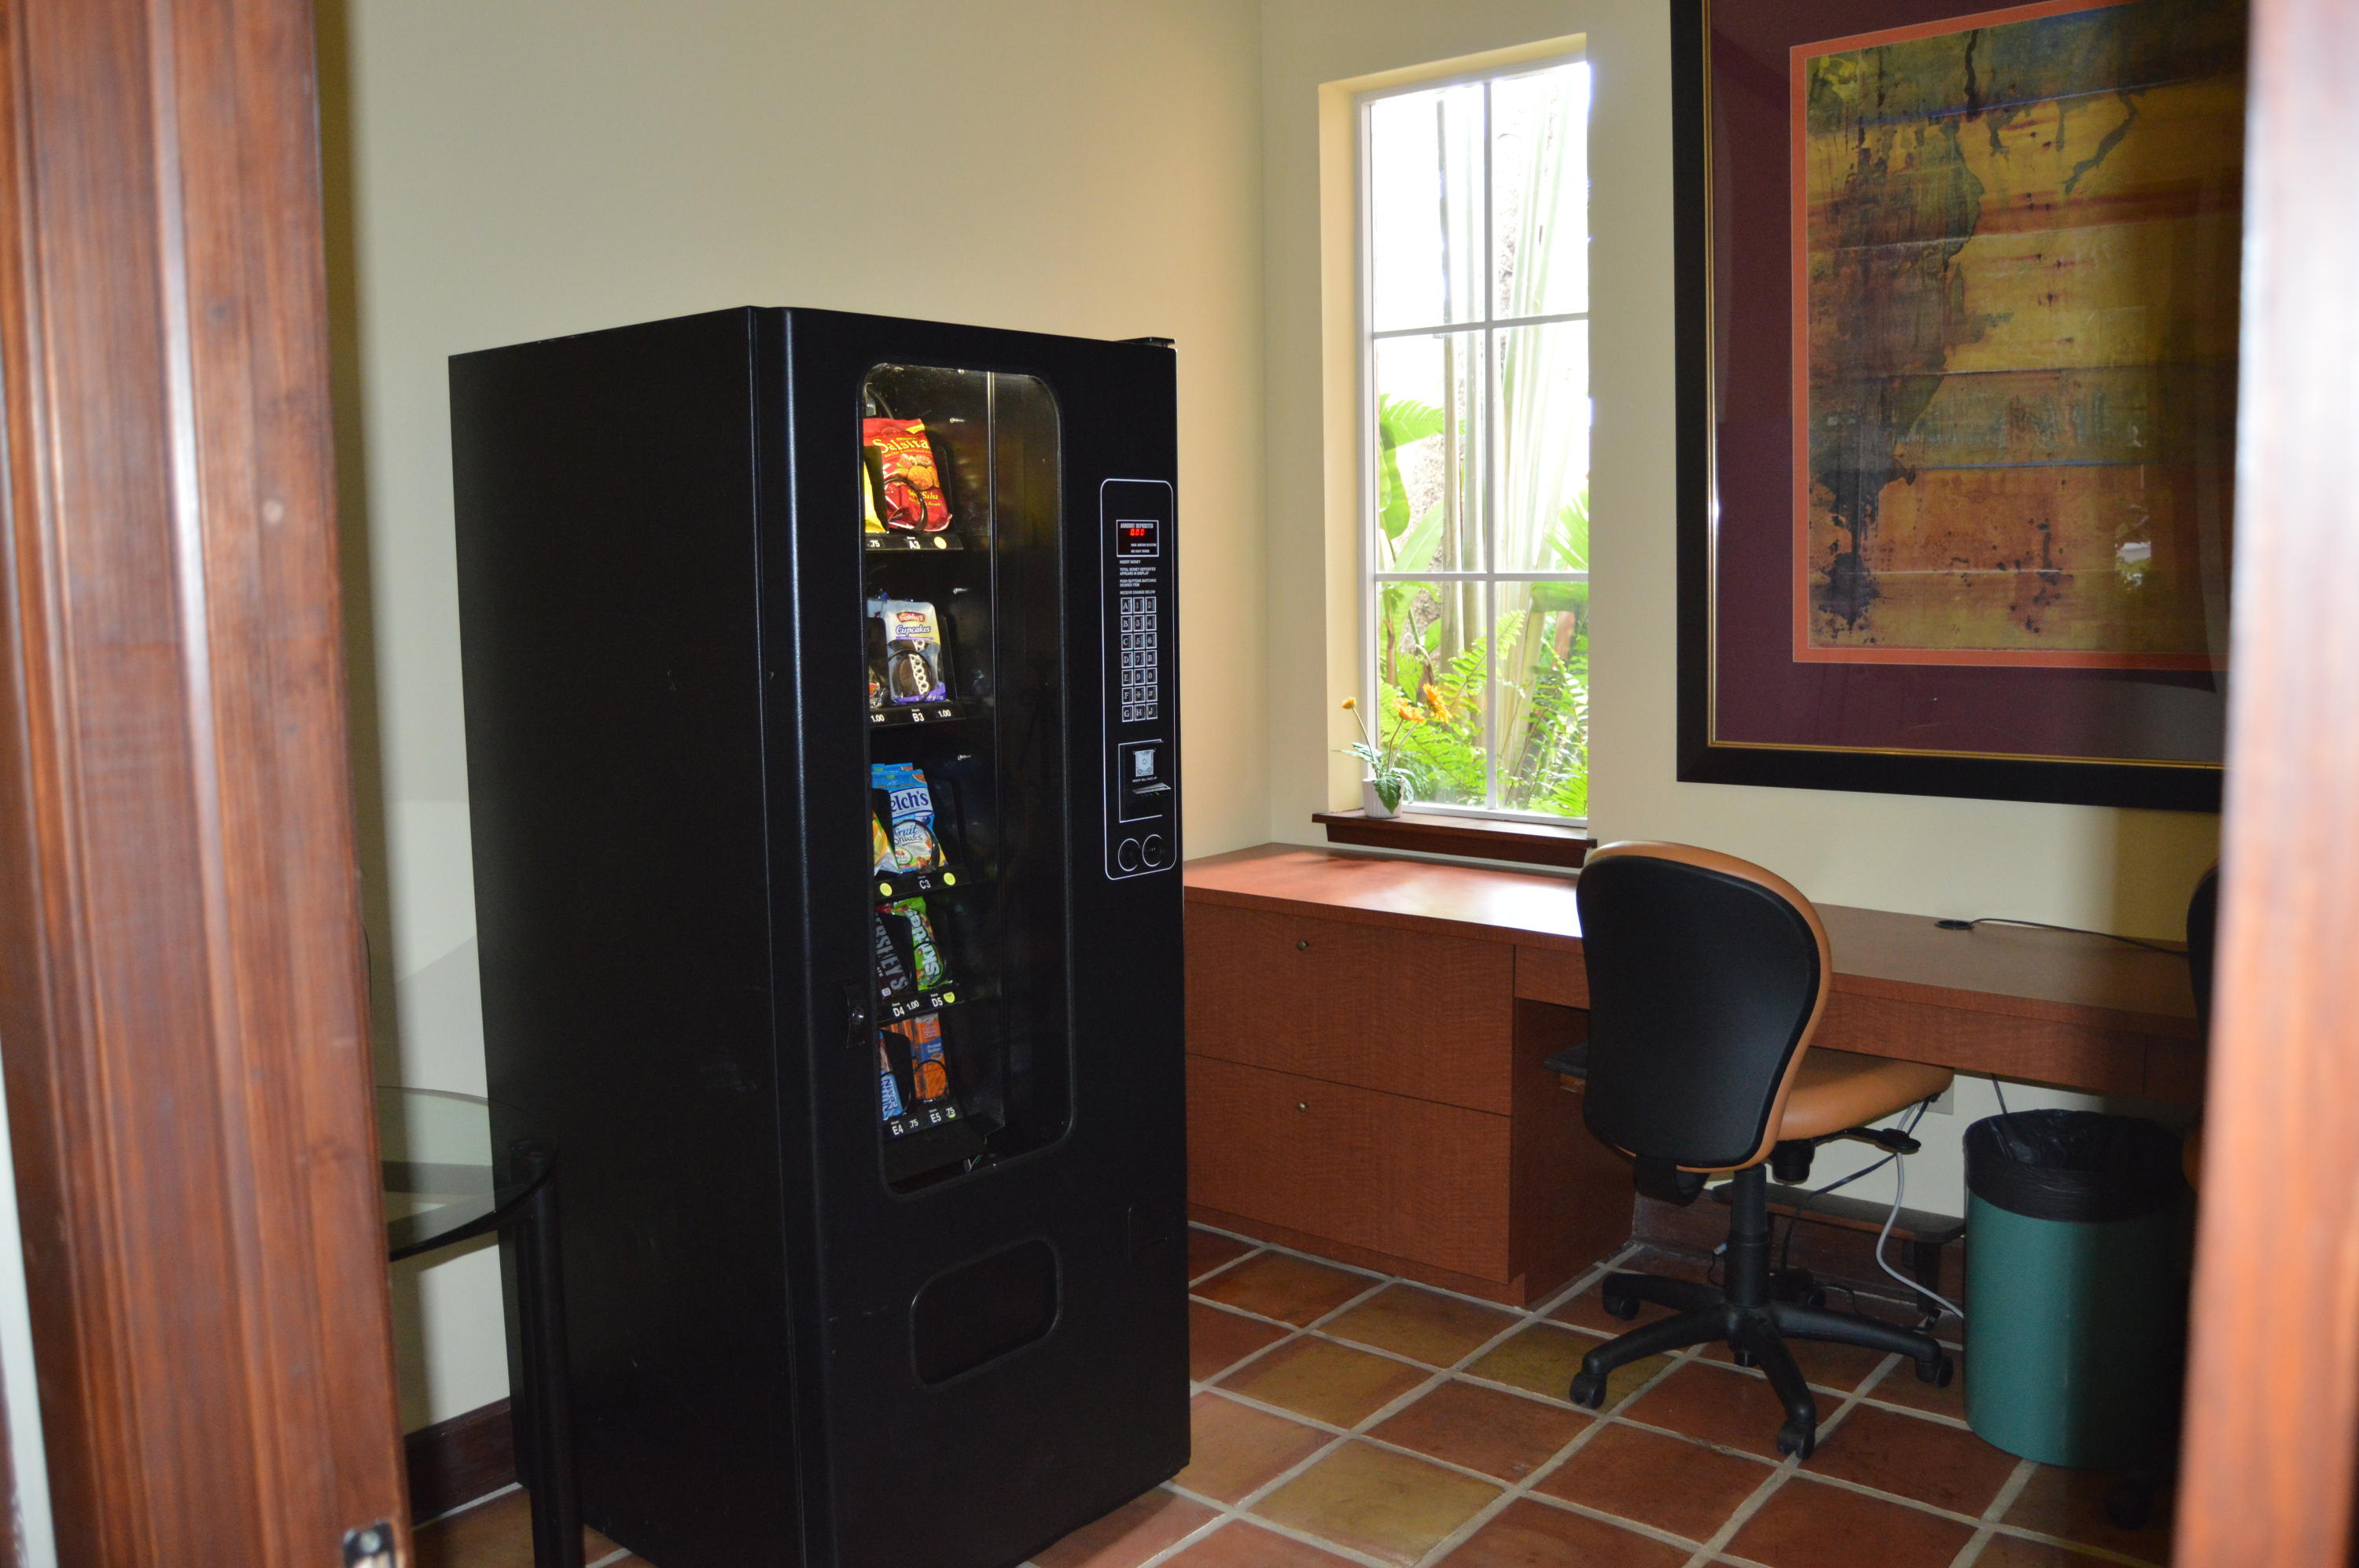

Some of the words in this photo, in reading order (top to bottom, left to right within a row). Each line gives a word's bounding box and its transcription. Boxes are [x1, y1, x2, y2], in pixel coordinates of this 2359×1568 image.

[872, 439, 931, 454] Salsita
[922, 491, 938, 499] Salsa
[909, 540, 921, 550] A3
[1122, 602, 1128, 610] A
[896, 624, 931, 637] Cupcakes
[870, 714, 885, 723] 1.00
[912, 712, 925, 722] B3
[890, 791, 929, 812] elch's
[919, 879, 931, 889] C3
[907, 999, 920, 1010] 1.00
[931, 997, 944, 1007] D5
[892, 1007, 905, 1017] D4
[930, 1112, 942, 1124] E5
[892, 1124, 904, 1136] E4
